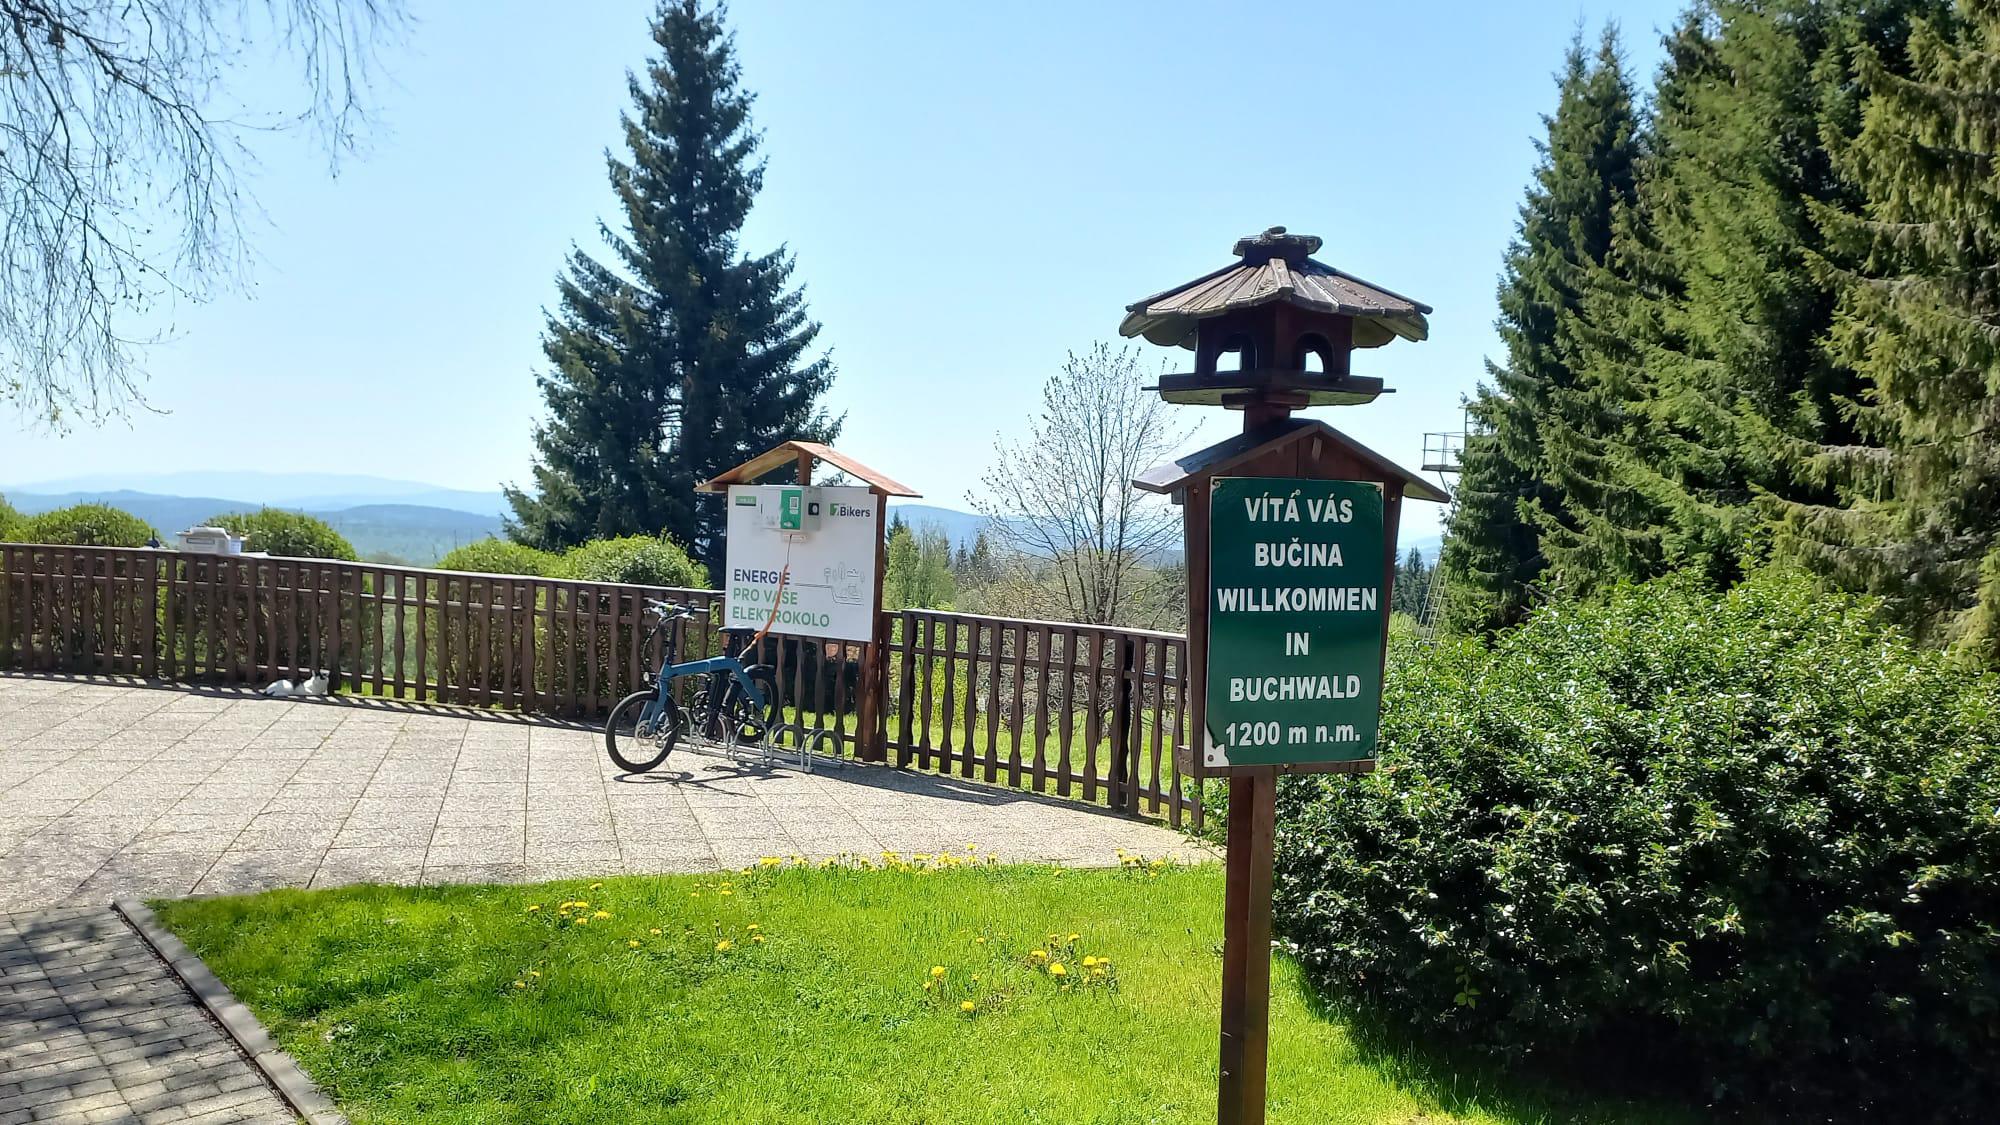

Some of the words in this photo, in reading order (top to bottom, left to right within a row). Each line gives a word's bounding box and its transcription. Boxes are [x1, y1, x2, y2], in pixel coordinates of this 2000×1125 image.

[1244, 492, 1300, 523] VÍTÁ
[1306, 493, 1353, 524] VÁS
[1254, 537, 1344, 567] BUČINA
[733, 587, 760, 602] PRO
[1216, 587, 1377, 612] WILLKOMMEN
[732, 606, 830, 627] ELEKTROKOLO
[1285, 632, 1310, 656] IN
[1229, 675, 1361, 702] BUCHWALD
[1225, 721, 1280, 747] 1200
[1288, 726, 1308, 744] m
[1315, 724, 1361, 744] n.m.
